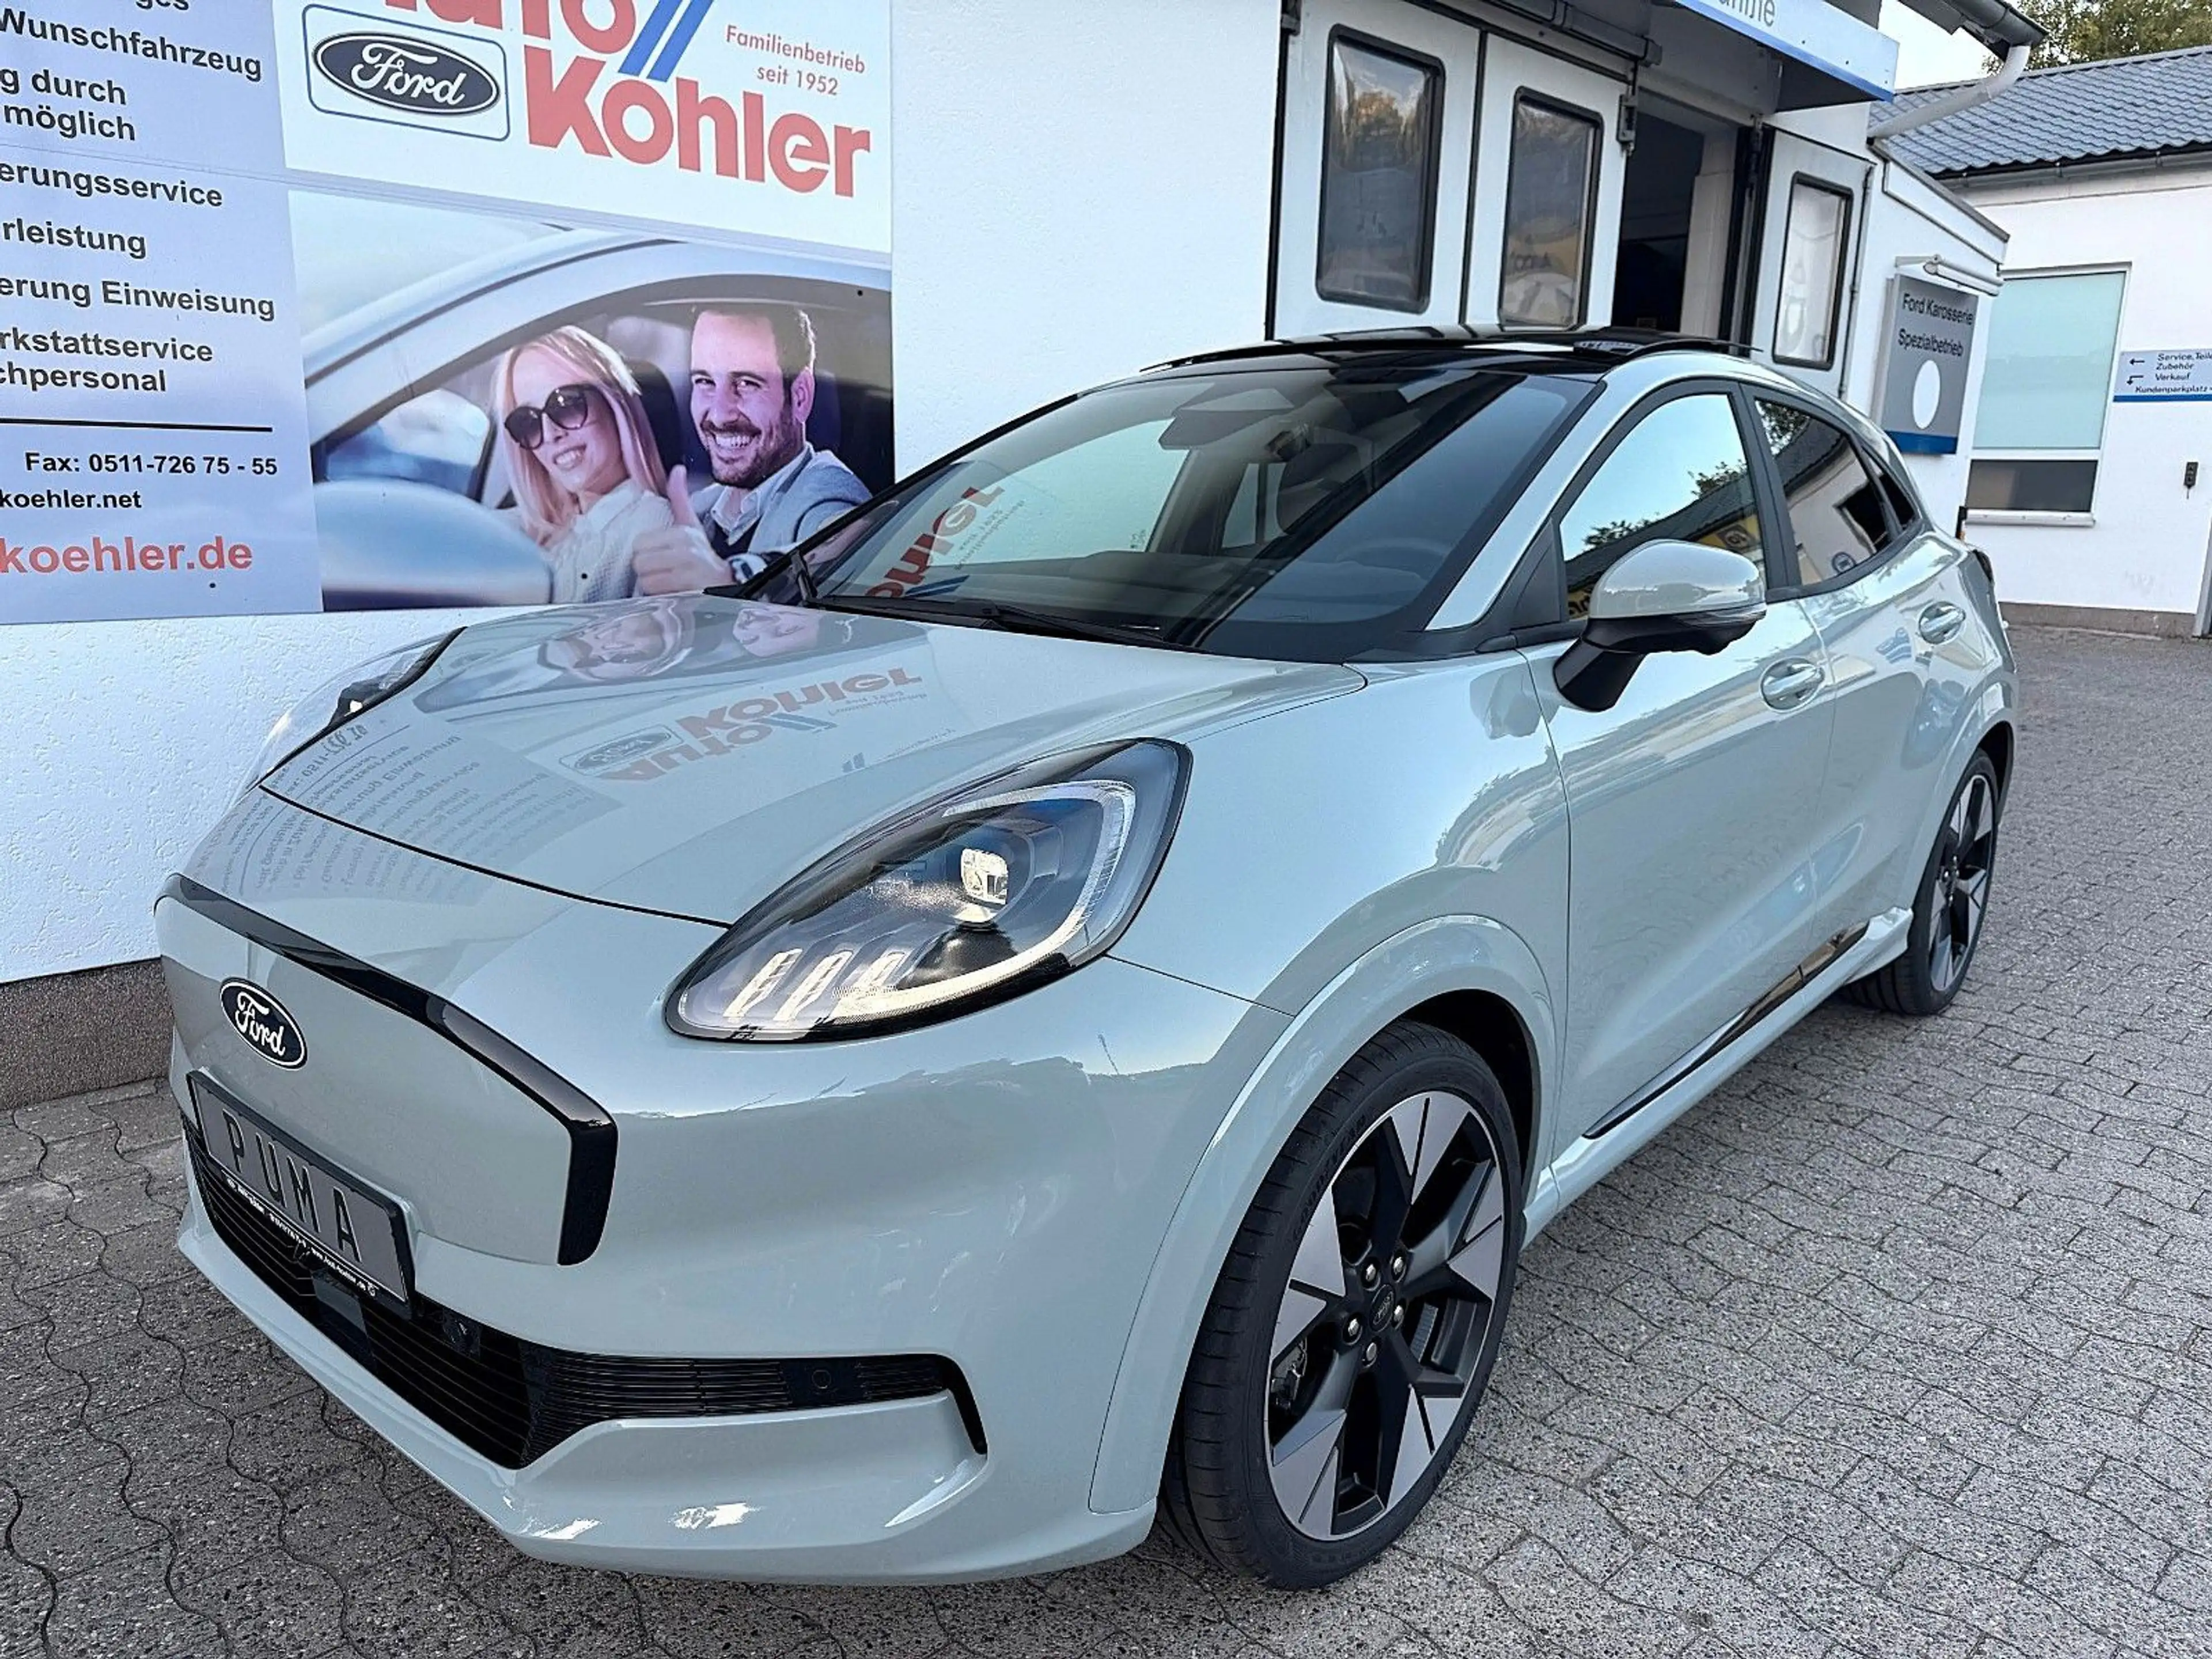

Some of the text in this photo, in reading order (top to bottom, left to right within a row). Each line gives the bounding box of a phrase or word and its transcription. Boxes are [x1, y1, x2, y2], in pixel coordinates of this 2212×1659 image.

[726, 24, 865, 74] Familienbetrieb
[32, 69, 126, 105] durch
[351, 43, 467, 105] Ford
[756, 65, 838, 96] seit 1952
[4, 105, 135, 141] möglich
[0, 163, 222, 207] erungsservice
[2, 218, 146, 259] rleistung
[0, 278, 274, 321] erung Einweisung
[1903, 293, 1925, 314] Ford
[0, 327, 213, 362] rkstattservice
[25, 452, 79, 472] Fax:
[89, 453, 196, 474] 0511-726
[203, 456, 230, 474] 75
[252, 457, 278, 475] 55
[0, 489, 142, 508] koehler.net
[0, 536, 253, 573] koehler.de
[236, 991, 286, 1056] Ford
[222, 1108, 362, 1263] PUMA
